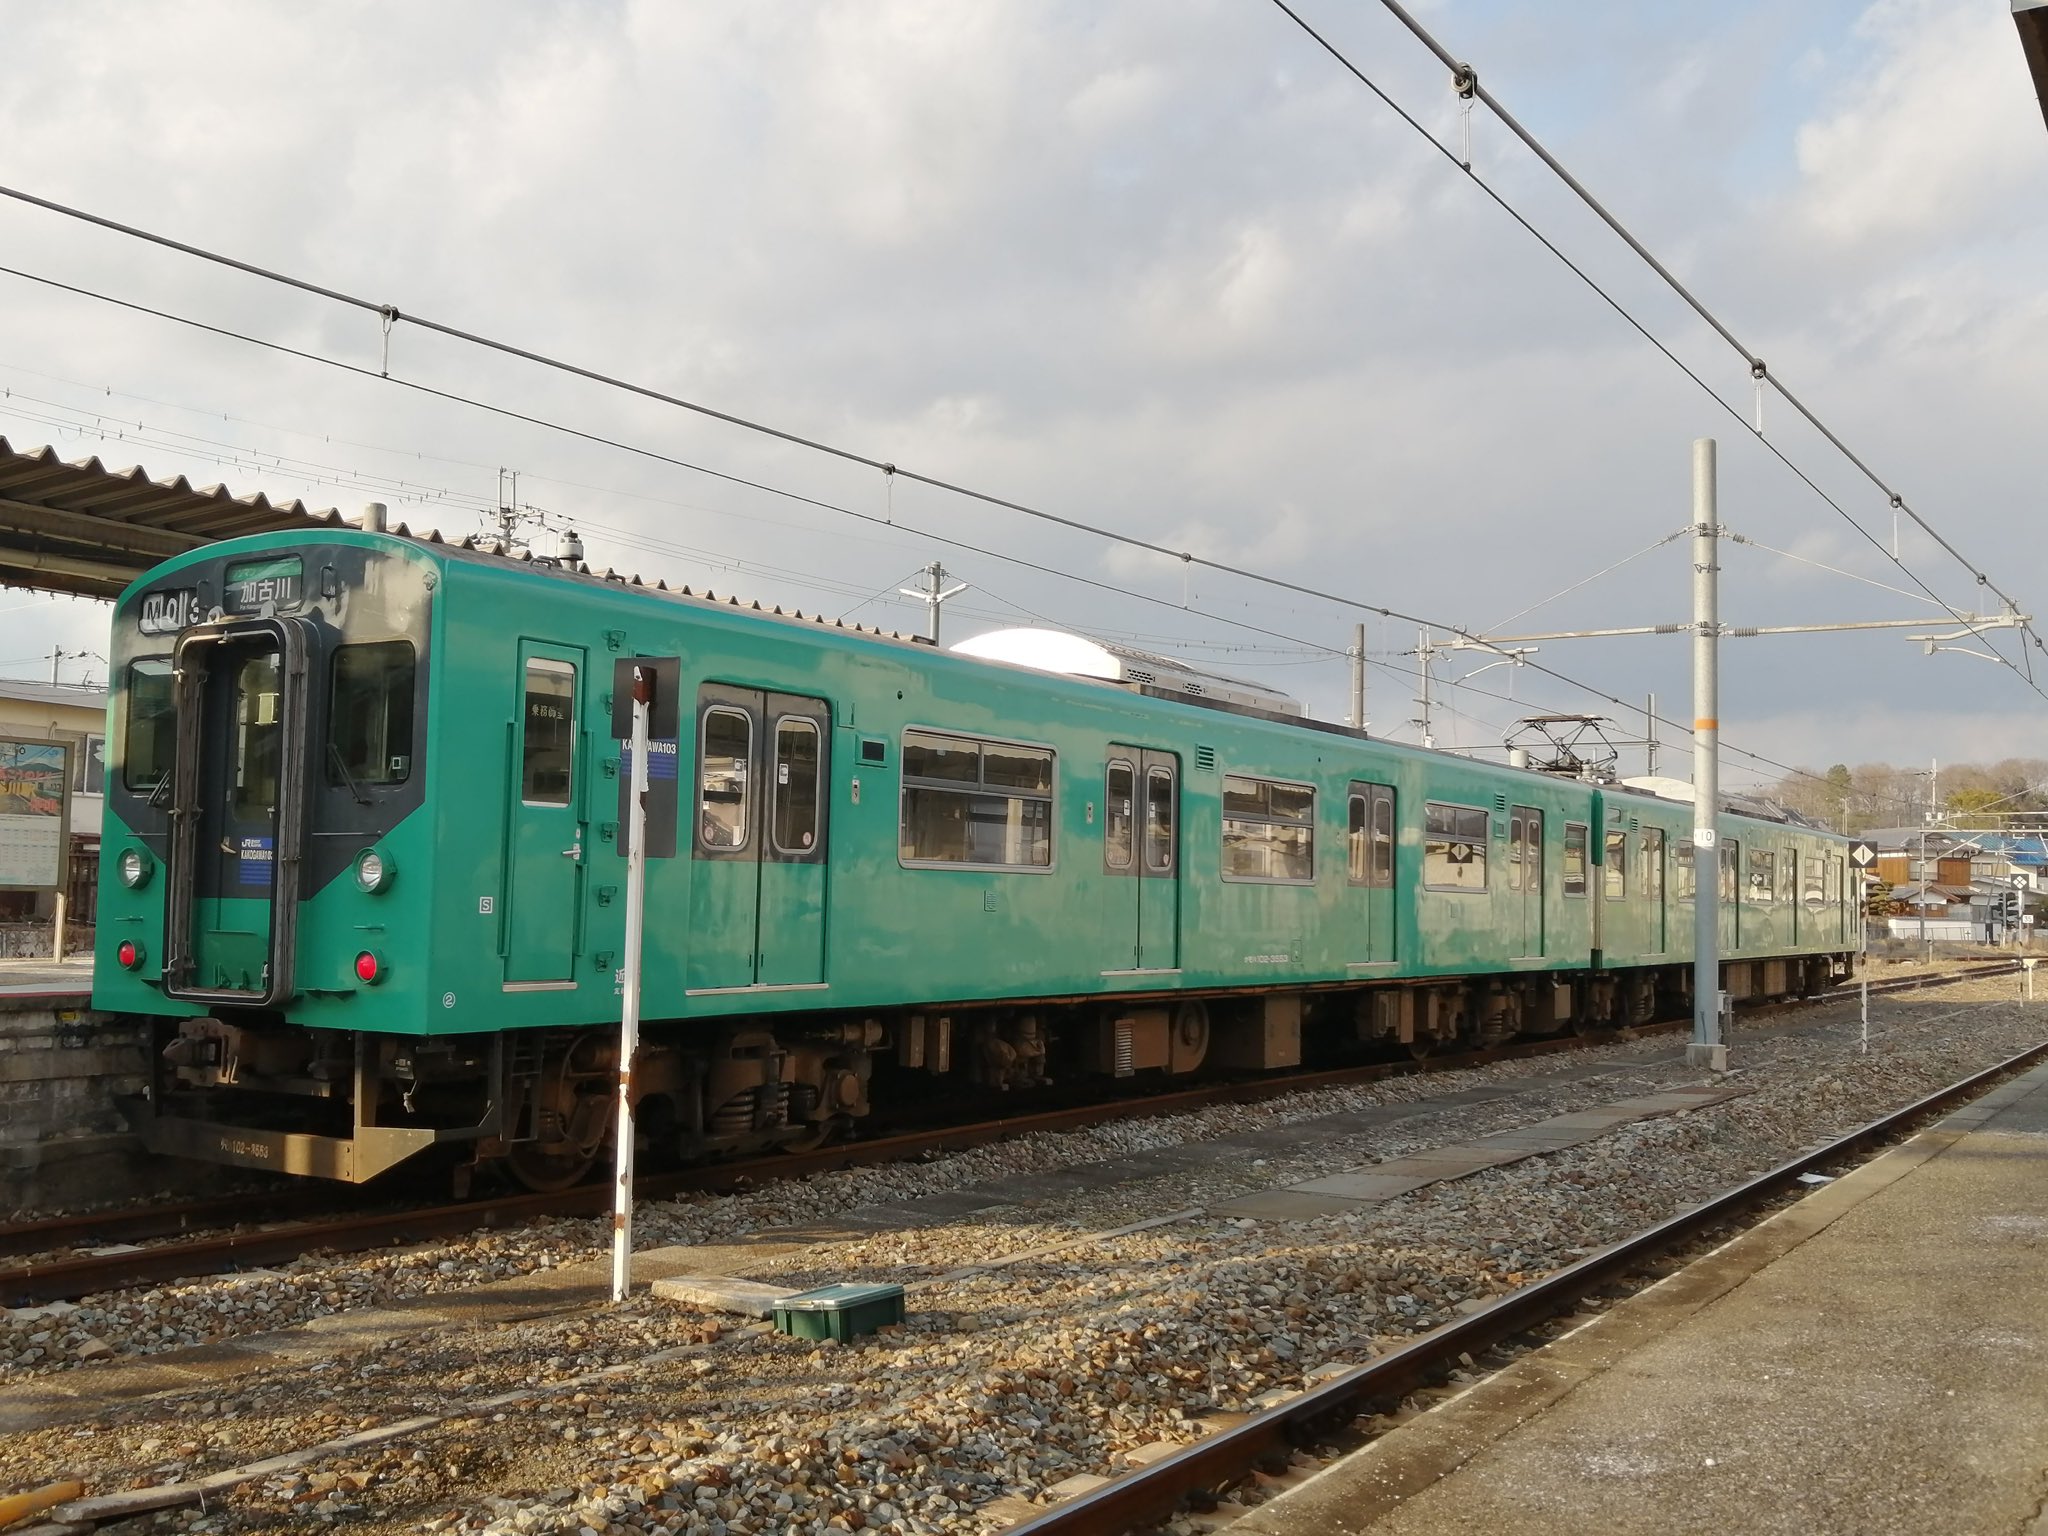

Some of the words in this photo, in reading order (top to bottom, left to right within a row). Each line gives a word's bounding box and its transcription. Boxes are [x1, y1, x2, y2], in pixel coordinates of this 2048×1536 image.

[240, 577, 291, 602] 加古川
[622, 739, 677, 755] KAAWA103
[481, 898, 492, 912] S
